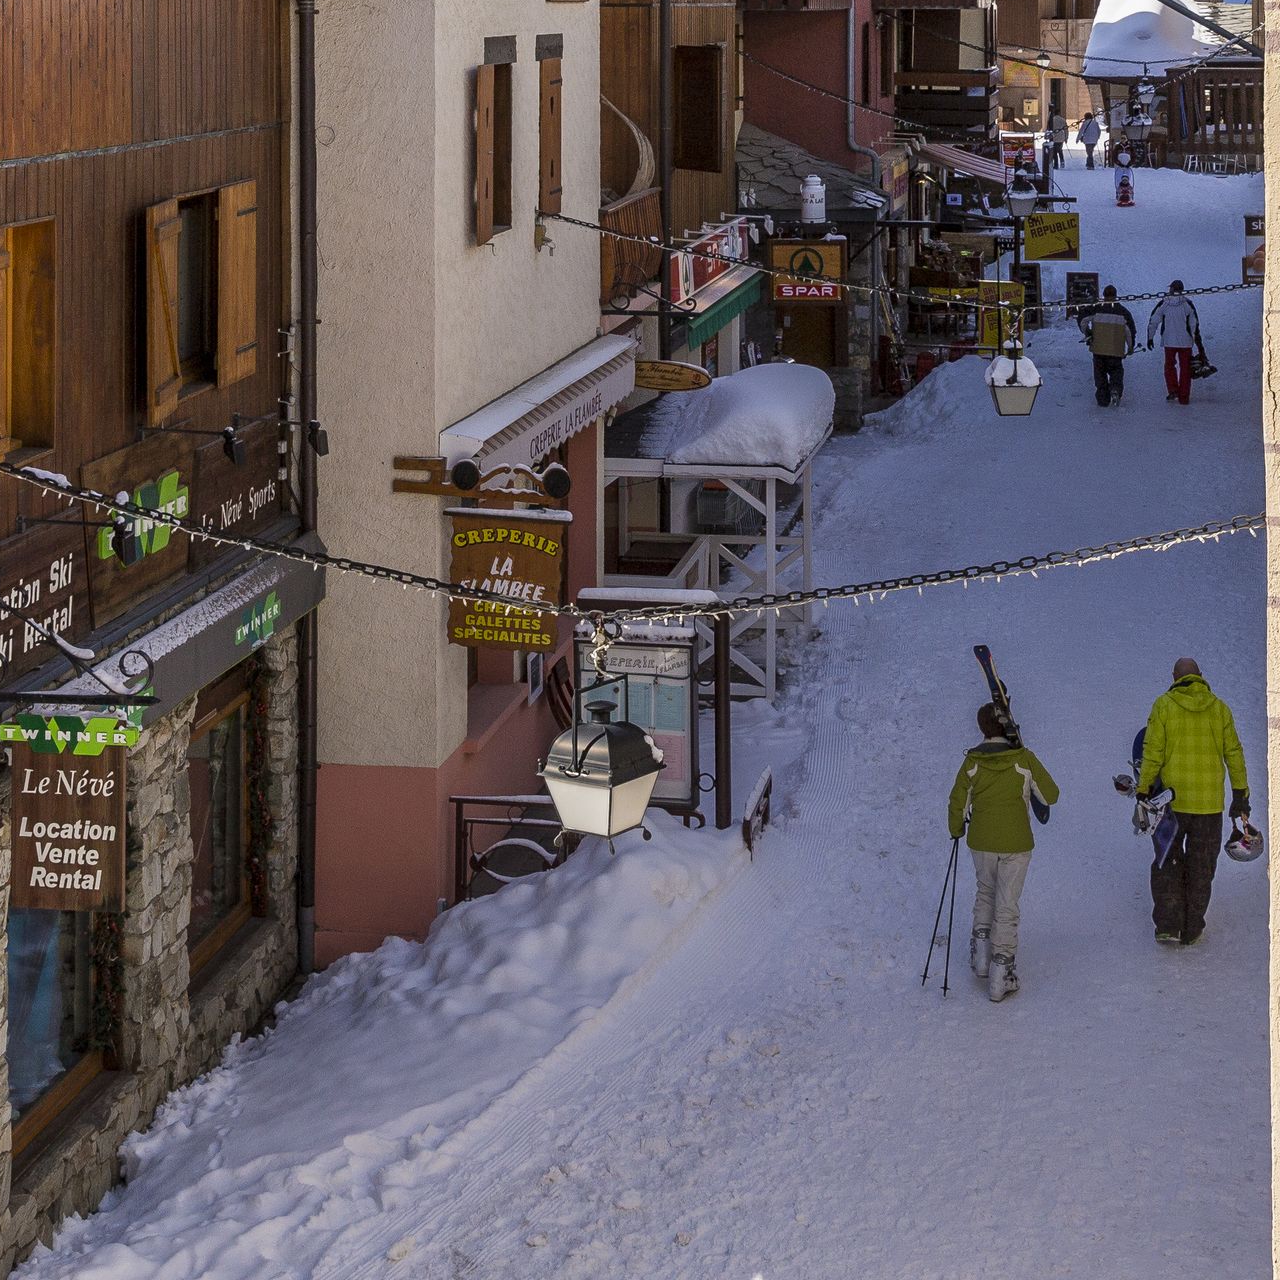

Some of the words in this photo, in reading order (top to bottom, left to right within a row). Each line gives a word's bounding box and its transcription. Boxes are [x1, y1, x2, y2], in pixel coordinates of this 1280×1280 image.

[1028, 214, 1044, 228] SKI
[782, 286, 833, 297] SPAR
[530, 419, 562, 459] CREPERIE
[565, 412, 574, 434] LA
[575, 388, 602, 427] FLAMBÉE
[220, 493, 243, 531] Névé
[248, 478, 276, 520] Sports
[453, 528, 560, 557] CREPERIE
[49, 552, 73, 594] Ski
[490, 556, 514, 577] LA
[236, 603, 279, 641] TWINNER
[465, 614, 541, 631] GALETTES
[454, 627, 552, 645] SPECIALITES
[4, 728, 127, 744] TWINNER
[21, 768, 51, 795] Le
[54, 769, 116, 798] Névé
[19, 816, 117, 842] Location
[35, 841, 100, 866] Vente
[29, 866, 103, 891] Rental
